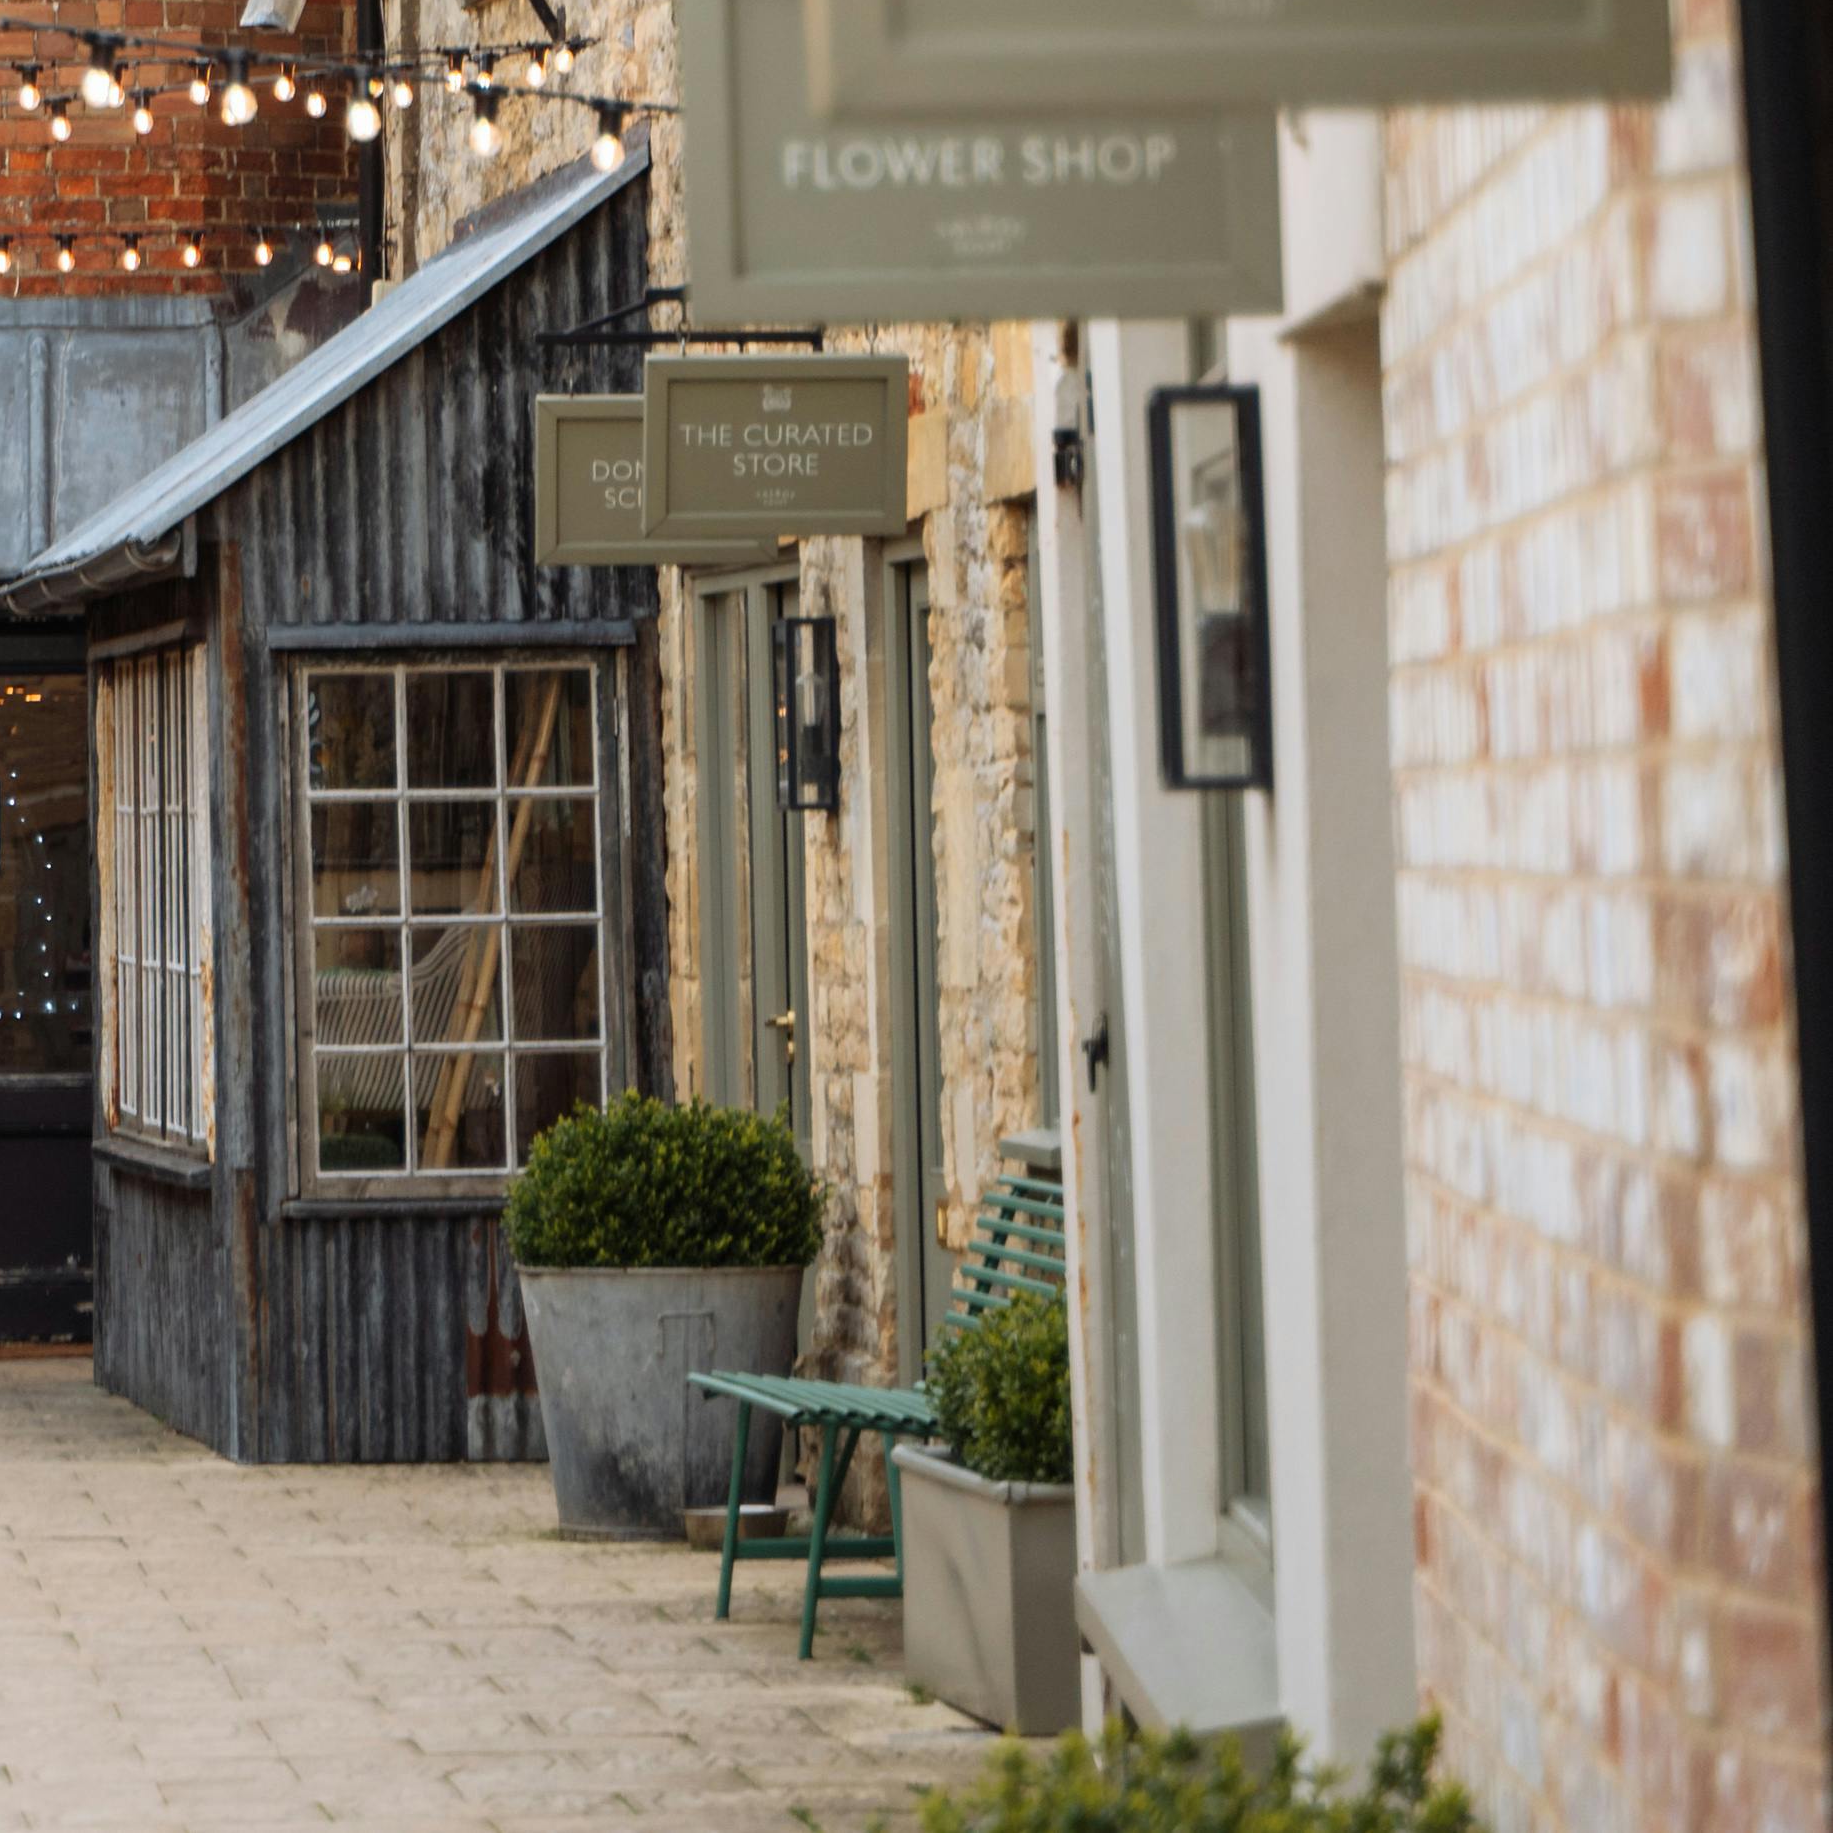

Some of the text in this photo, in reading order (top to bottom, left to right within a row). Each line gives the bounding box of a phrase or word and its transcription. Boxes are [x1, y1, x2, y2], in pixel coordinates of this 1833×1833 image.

[783, 133, 1176, 190] FLOWER SHOP
[679, 423, 874, 447] THE CURATED
[732, 453, 820, 477] STORE
